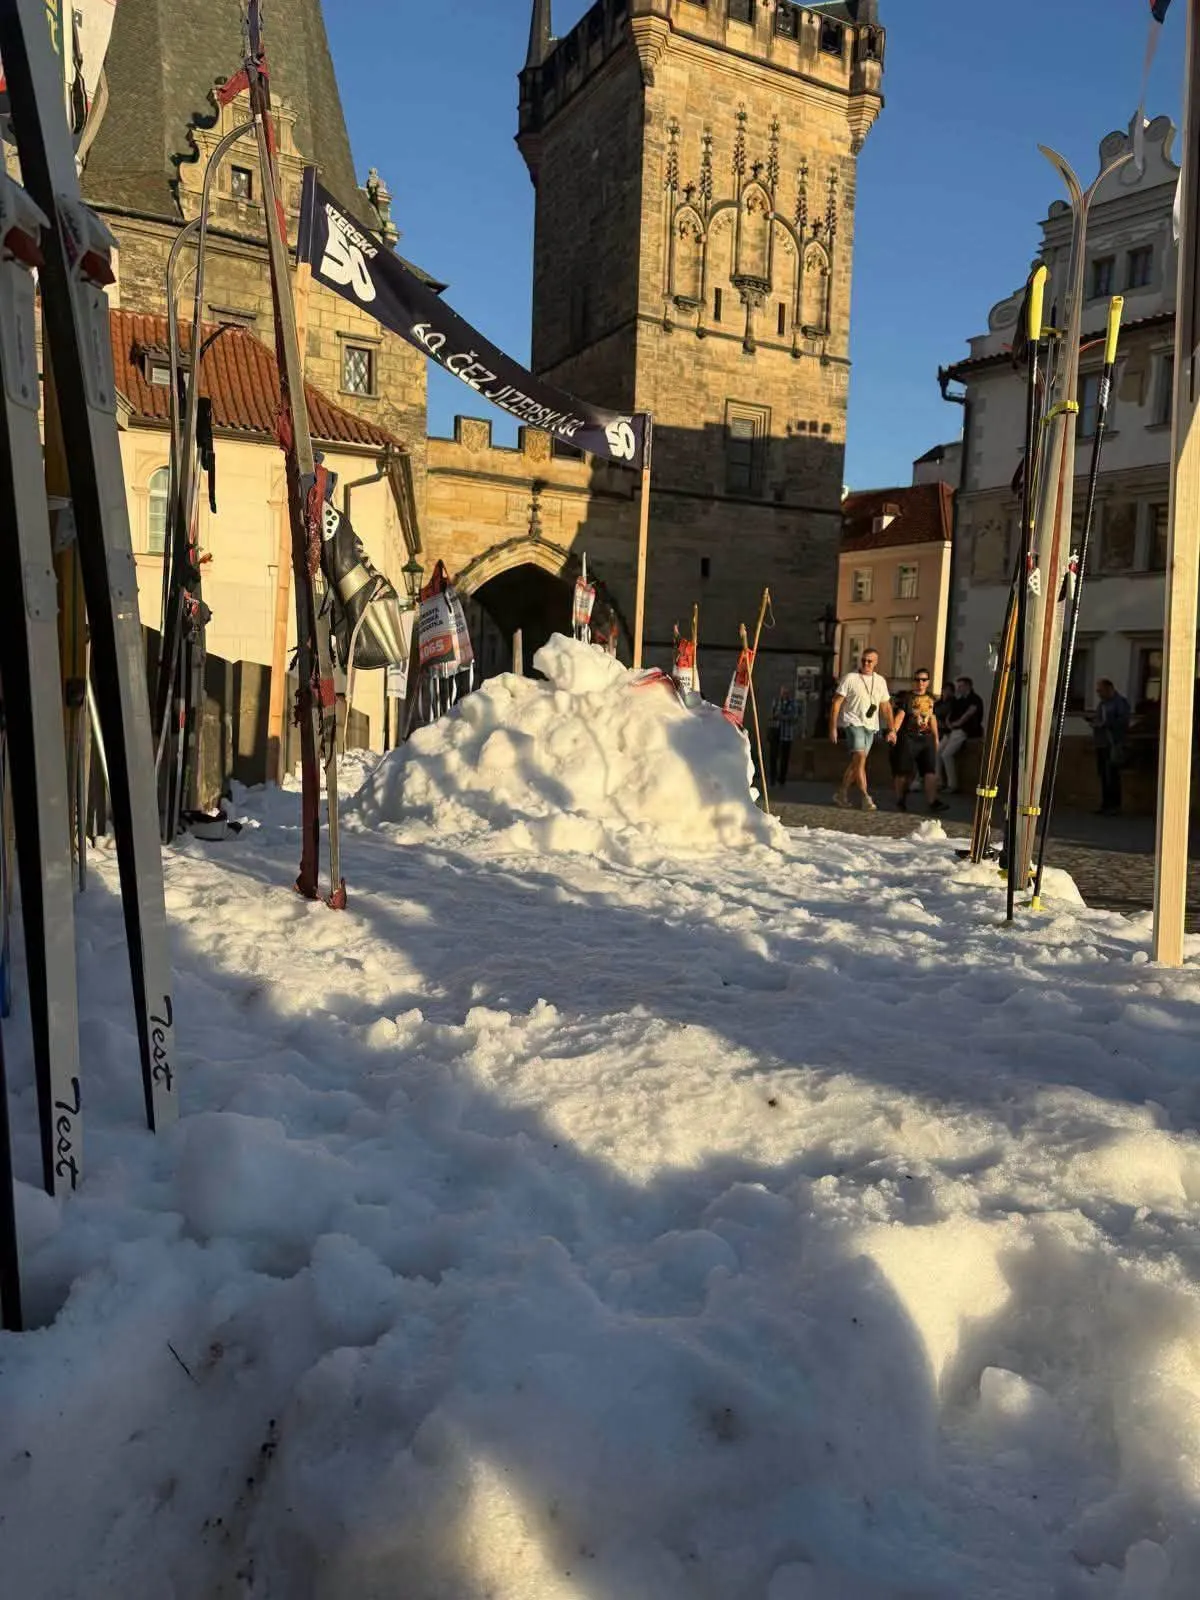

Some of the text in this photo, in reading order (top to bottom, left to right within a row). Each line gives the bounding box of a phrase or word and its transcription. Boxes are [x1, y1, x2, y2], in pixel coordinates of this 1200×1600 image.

[320, 215, 376, 301] 50
[447, 350, 497, 390] ČEZ
[605, 421, 635, 460] 50
[150, 995, 174, 1092] Test
[55, 1077, 81, 1191] Test
